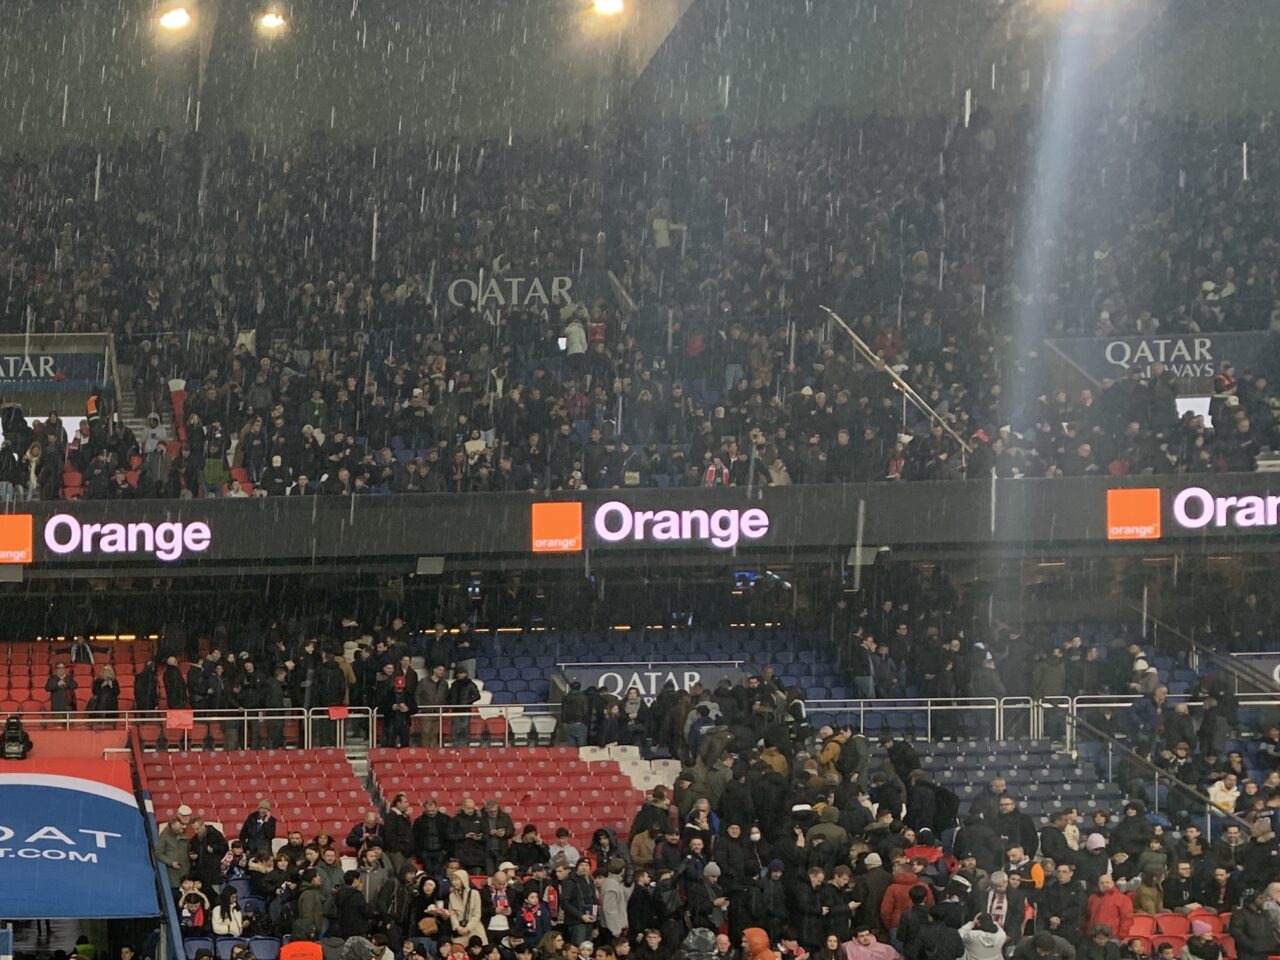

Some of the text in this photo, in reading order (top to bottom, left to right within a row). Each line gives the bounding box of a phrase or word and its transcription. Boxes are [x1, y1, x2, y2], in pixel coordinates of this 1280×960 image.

[448, 276, 573, 307] QATAR
[1105, 338, 1213, 369] QATAR
[45, 513, 212, 561] Orange
[595, 501, 769, 548] Orange
[1111, 525, 1155, 537] orange
[535, 538, 577, 549] orange
